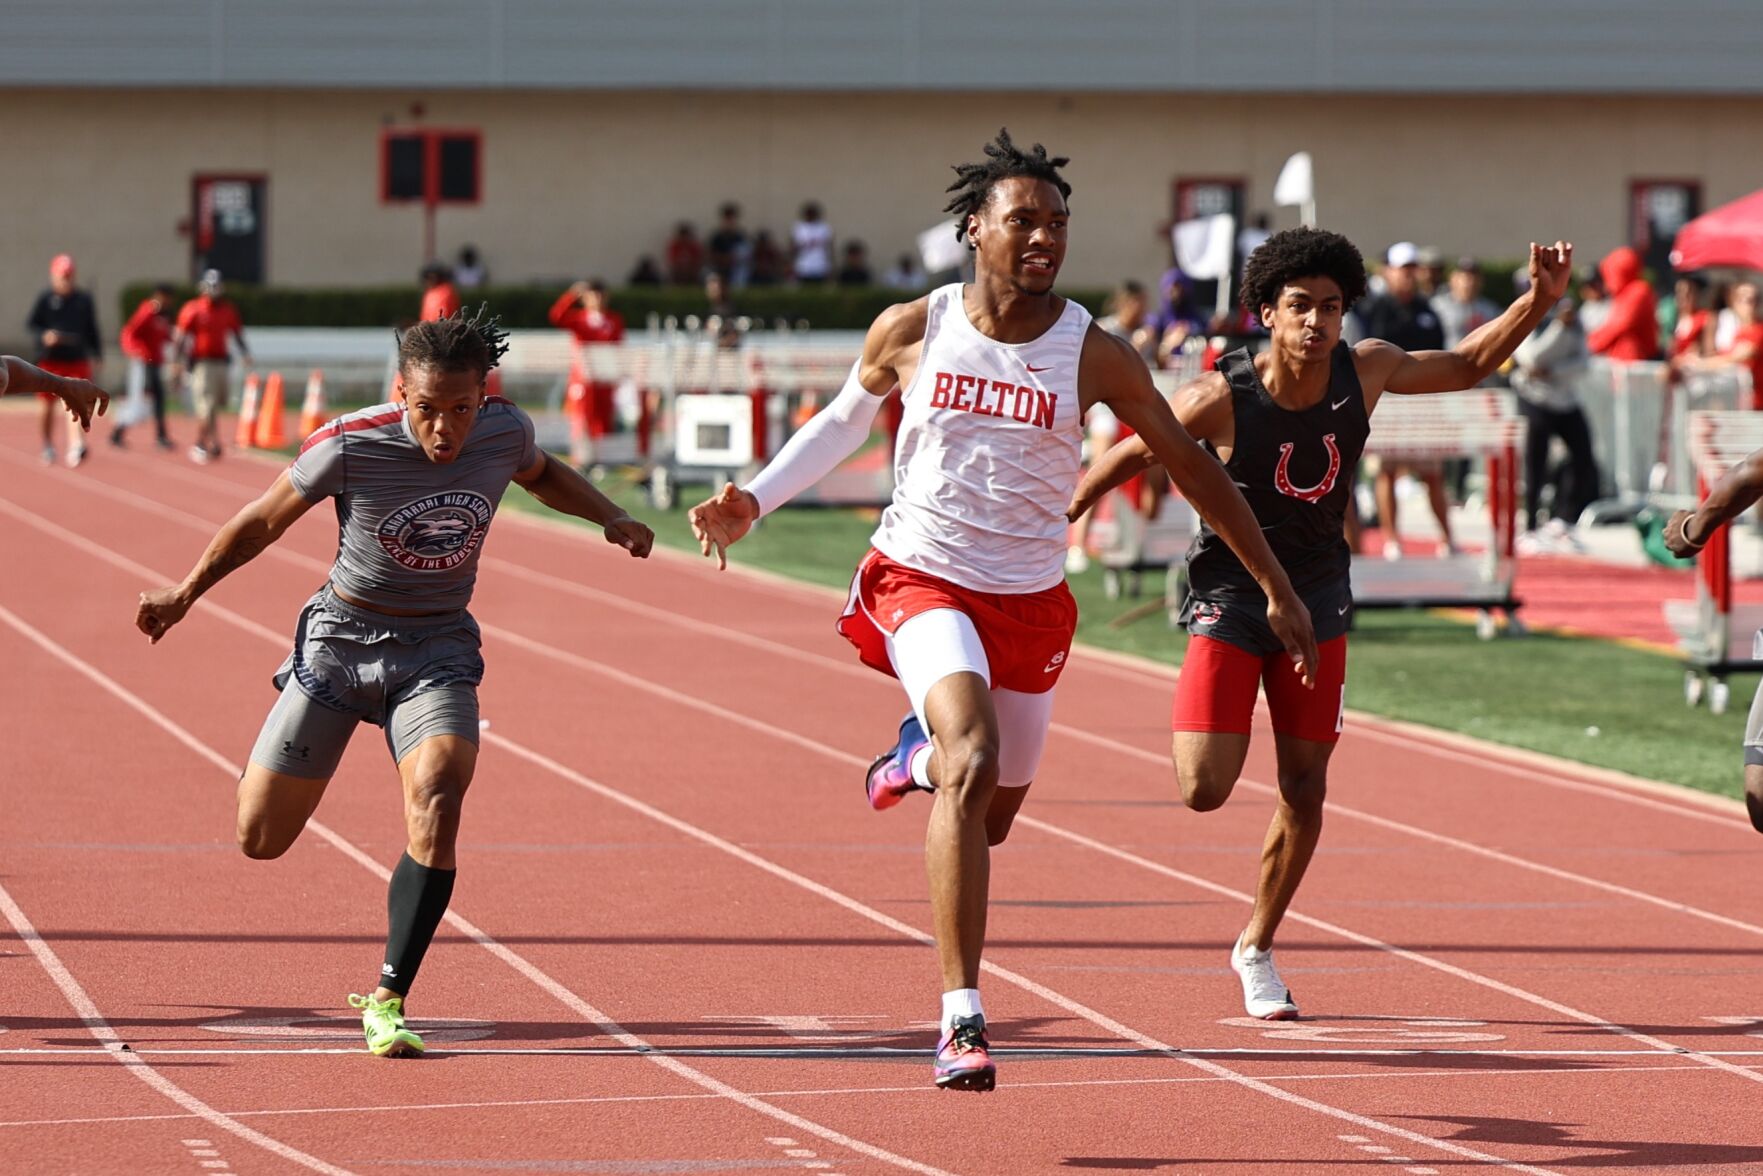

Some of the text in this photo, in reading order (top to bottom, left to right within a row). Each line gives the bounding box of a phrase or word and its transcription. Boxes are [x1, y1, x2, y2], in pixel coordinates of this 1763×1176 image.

[930, 371, 1058, 430] BELTON
[382, 494, 489, 536] CHAPARRAL HIGH SCHOOL
[421, 559, 441, 569] THE
